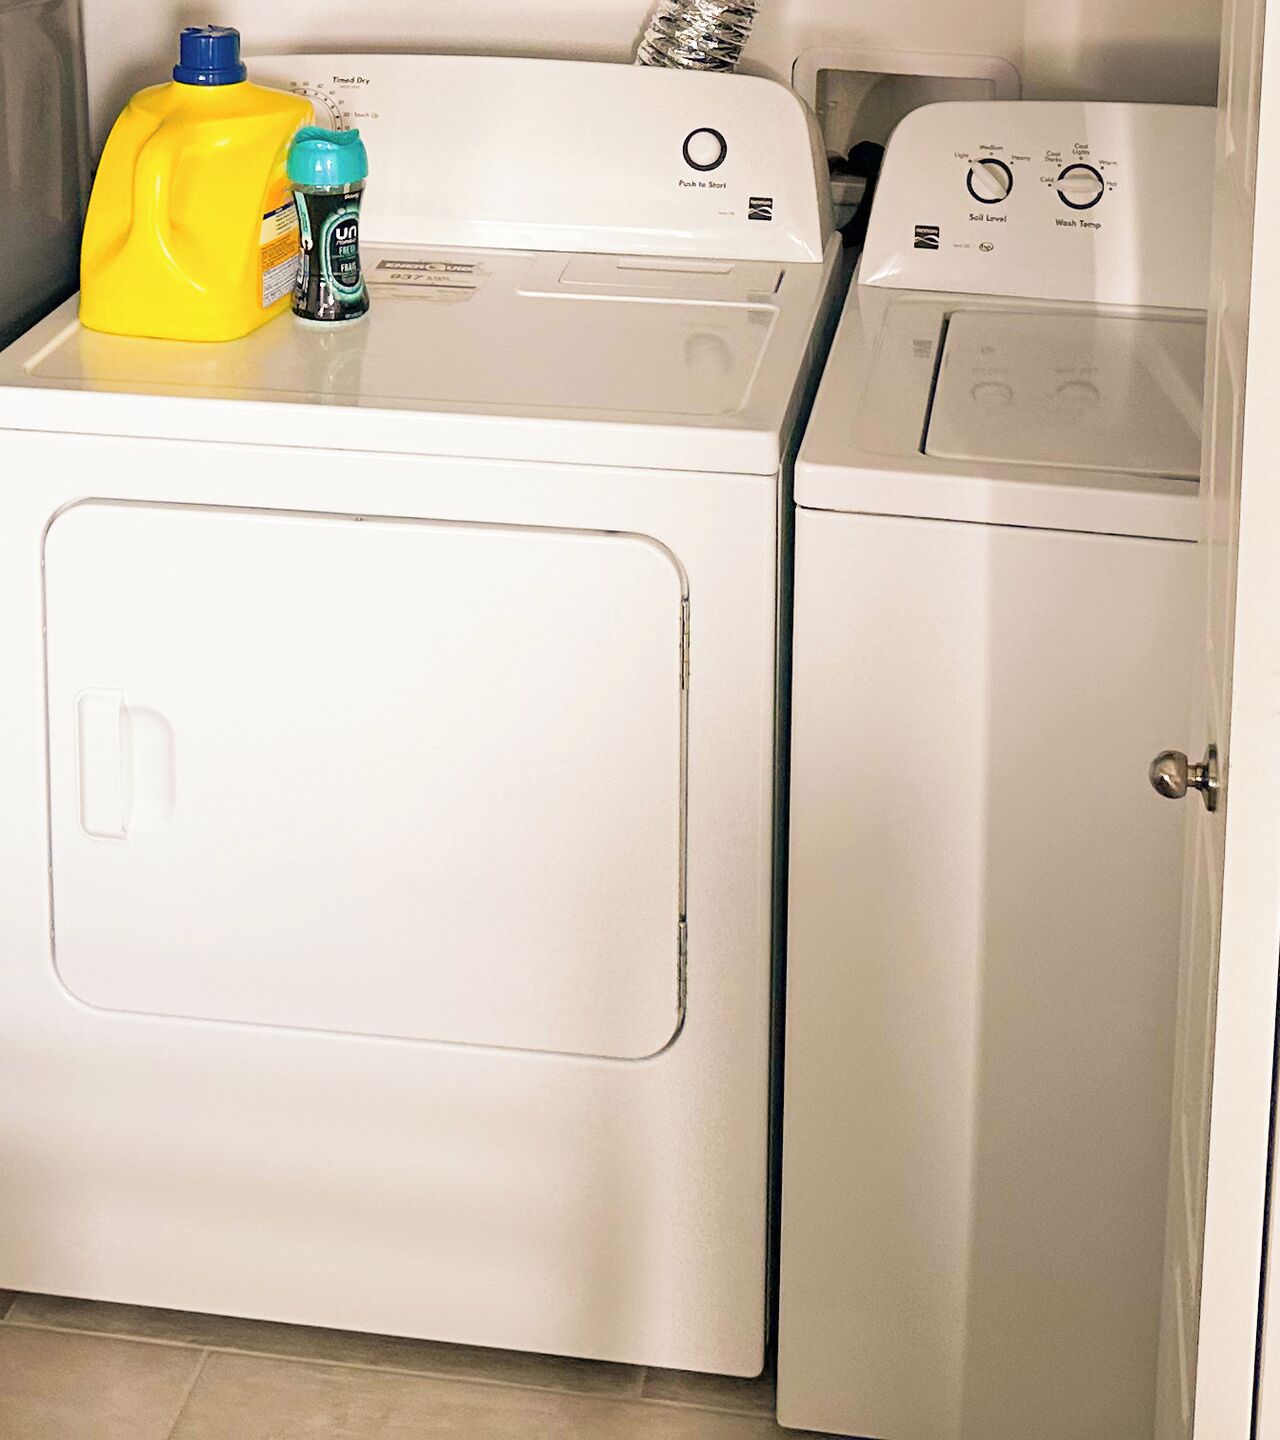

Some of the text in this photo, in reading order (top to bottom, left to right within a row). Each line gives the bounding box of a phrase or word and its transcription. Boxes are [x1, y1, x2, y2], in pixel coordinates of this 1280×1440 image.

[332, 76, 370, 85] Timed Dry
[678, 180, 697, 188] Push
[708, 181, 727, 189] Start
[969, 212, 1007, 222] Soil Level
[1055, 218, 1102, 230] Wash Temp
